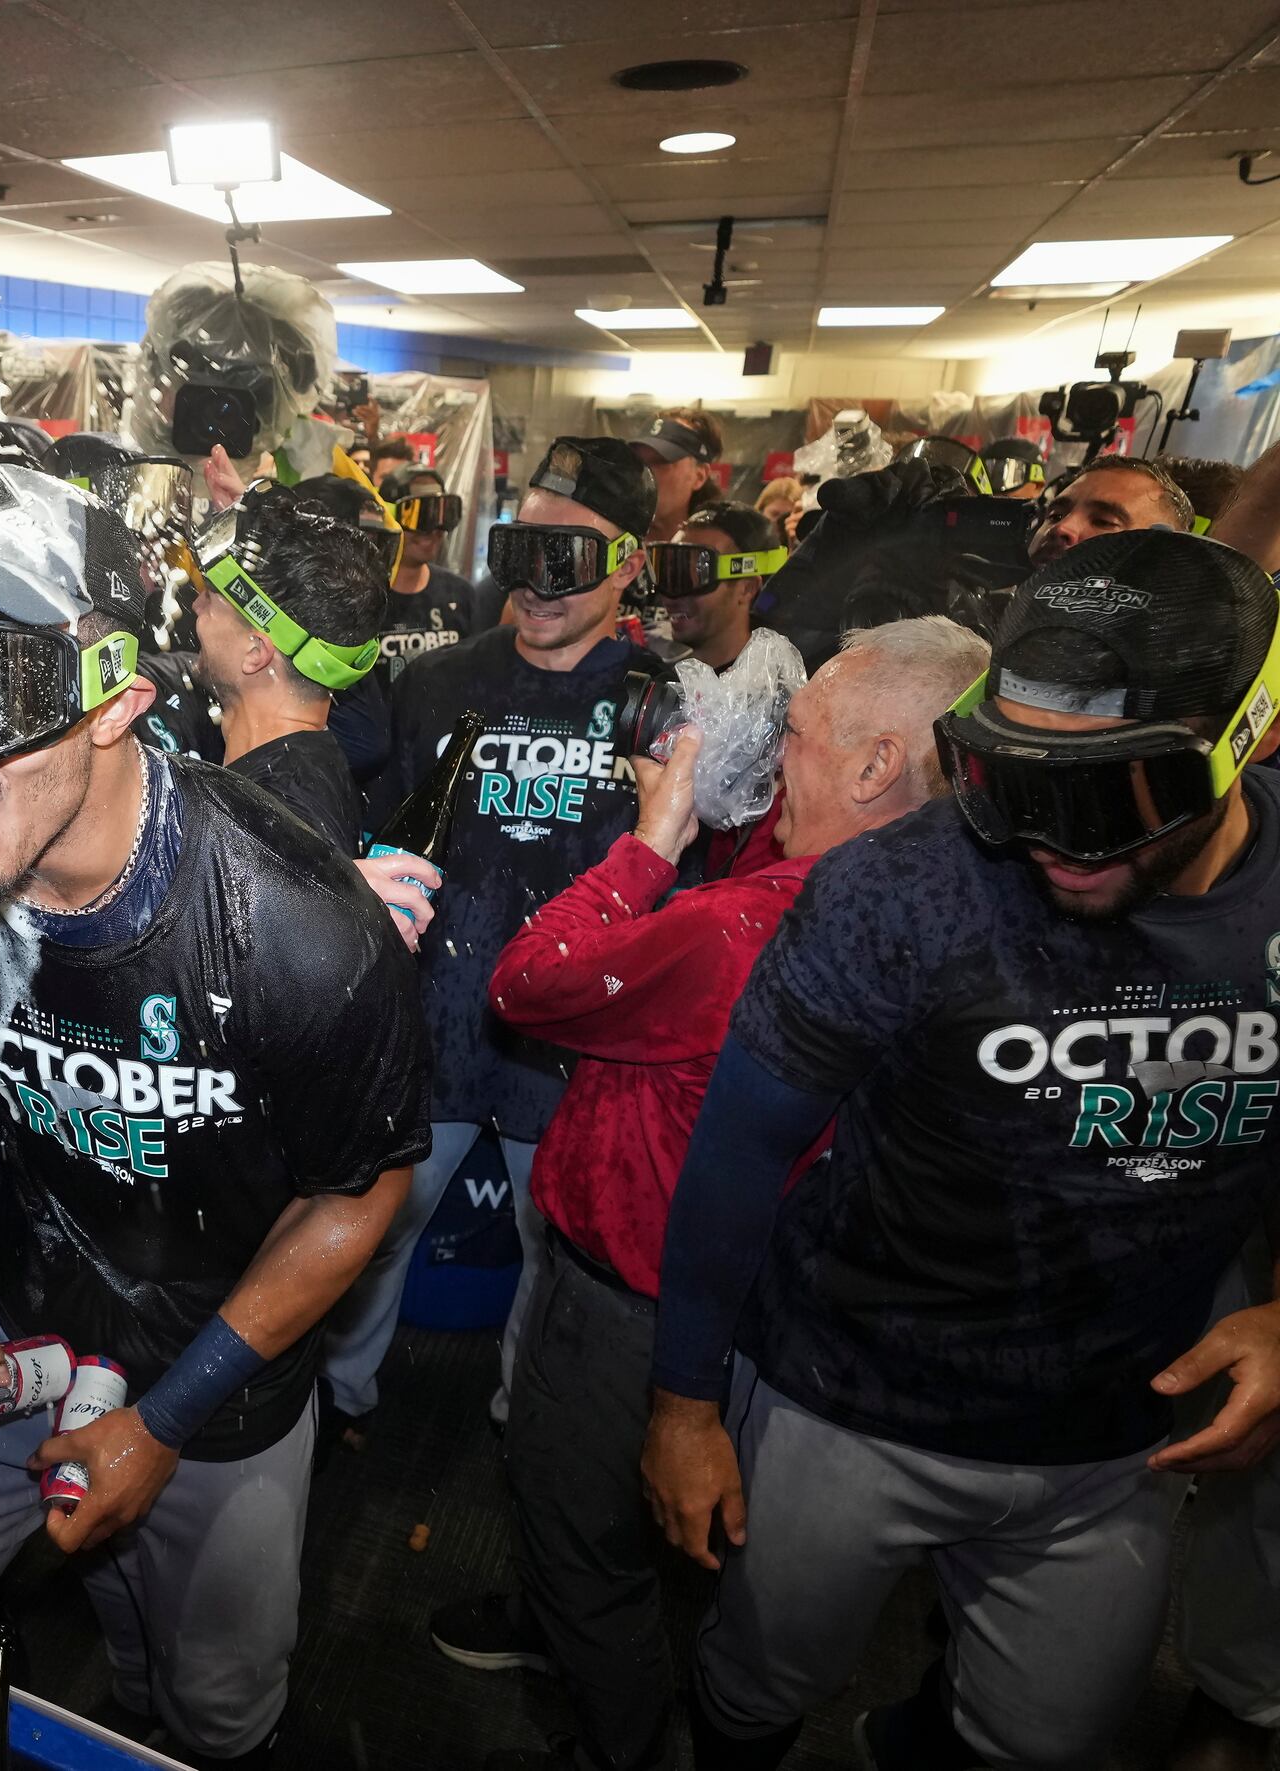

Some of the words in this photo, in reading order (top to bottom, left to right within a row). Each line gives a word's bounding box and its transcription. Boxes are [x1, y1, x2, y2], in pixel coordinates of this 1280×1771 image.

[990, 519, 1012, 527] SONY
[1041, 586, 1146, 606] POSTSEASON
[249, 604, 267, 622] ERA
[252, 600, 271, 617] NEW
[478, 772, 588, 823] RISE
[596, 780, 616, 791] 22
[500, 825, 551, 836] POSTSEASON
[60, 1035, 121, 1052] BASEBALL
[1024, 1086, 1062, 1100] 20
[1068, 1080, 1280, 1148] RISE
[15, 1082, 169, 1178] RISE
[177, 1116, 206, 1134] 22
